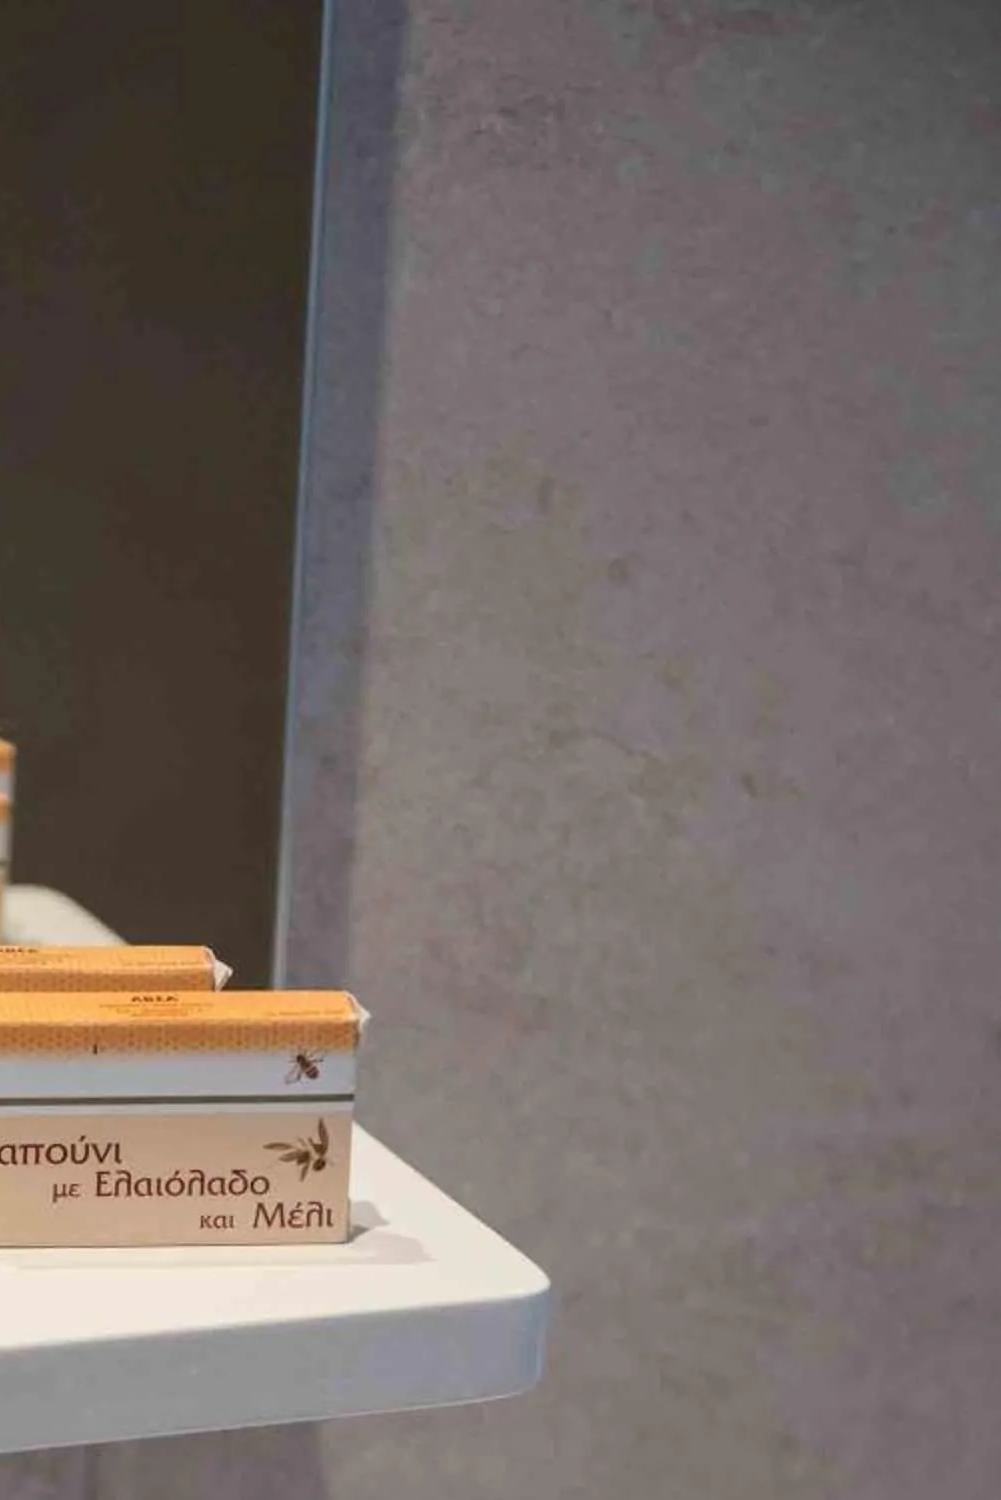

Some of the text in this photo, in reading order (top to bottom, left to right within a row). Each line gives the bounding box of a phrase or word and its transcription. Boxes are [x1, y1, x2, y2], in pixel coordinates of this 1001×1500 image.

[52, 1169, 271, 1203] με Ελαιόλαδο
[198, 1200, 335, 1230] και Μέλι
